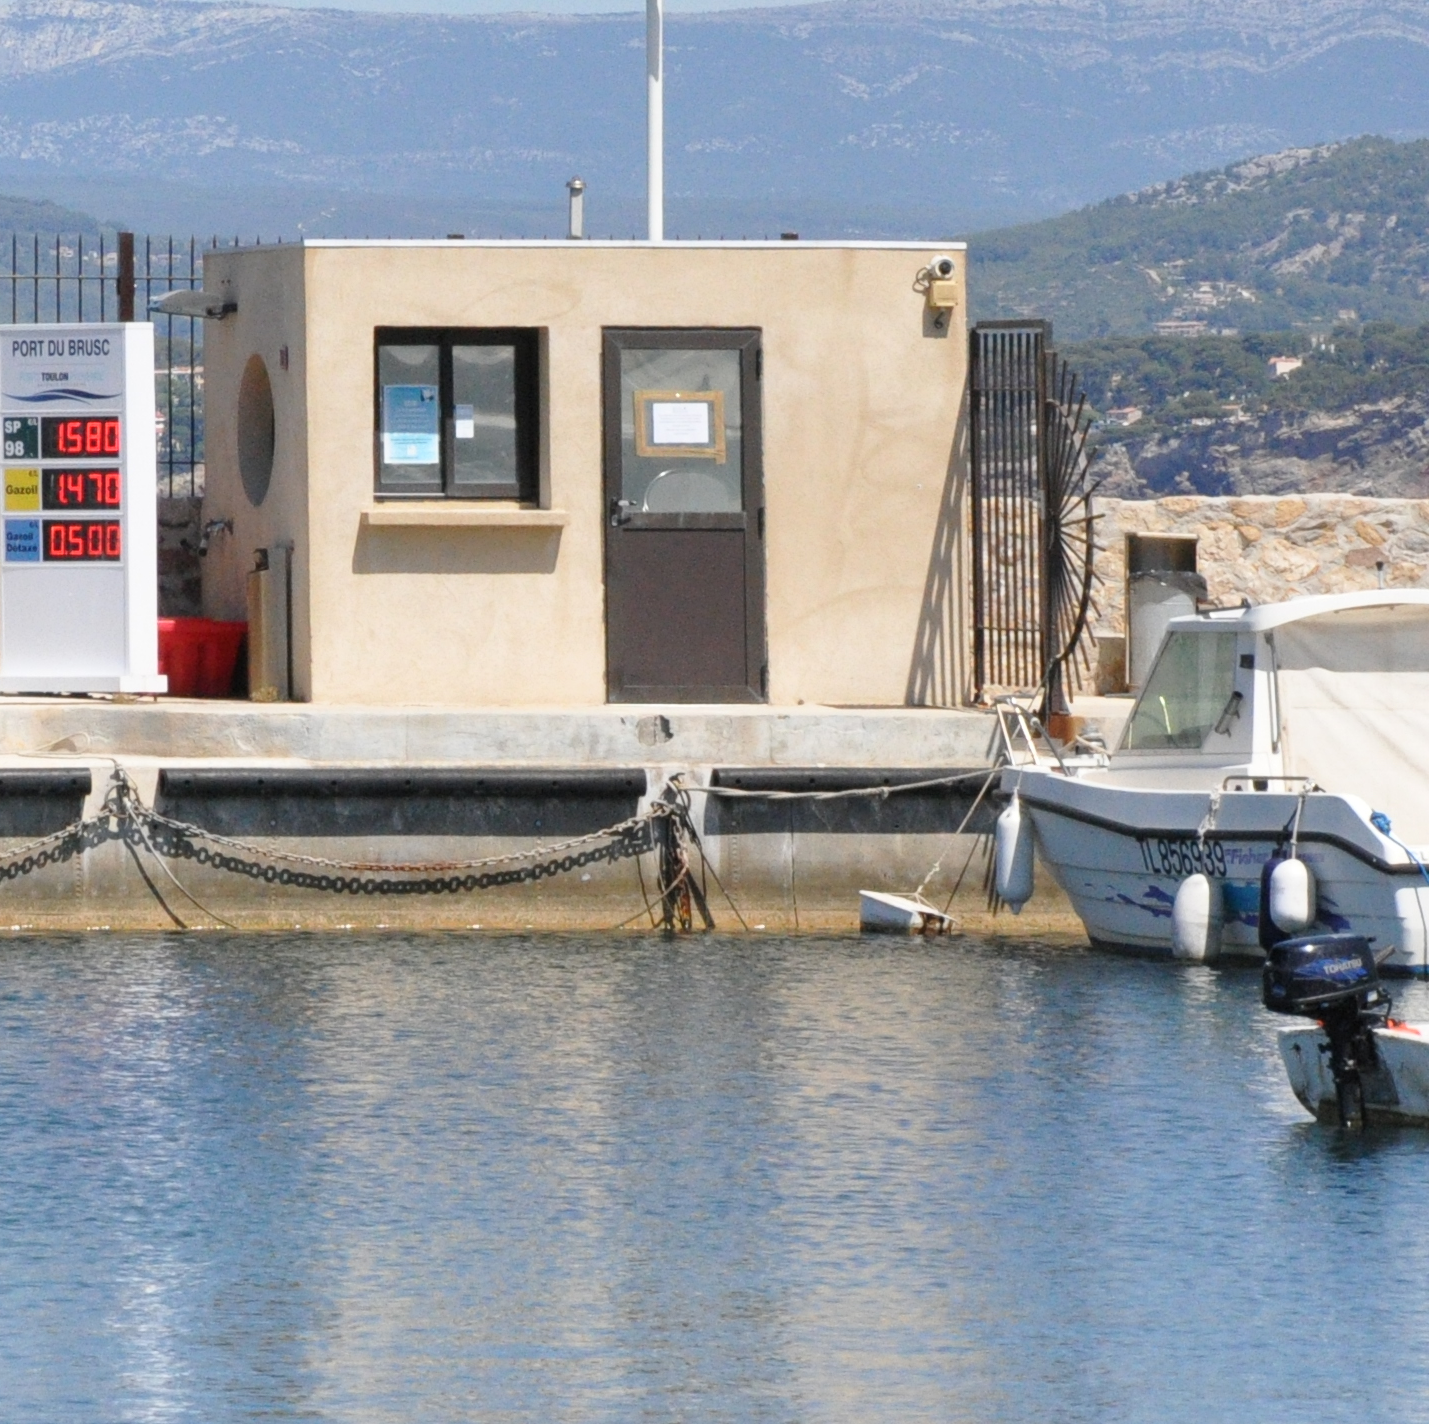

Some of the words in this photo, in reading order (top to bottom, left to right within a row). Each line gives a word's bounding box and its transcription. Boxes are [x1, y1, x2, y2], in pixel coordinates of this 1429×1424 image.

[12, 340, 44, 356] PORT
[48, 339, 65, 356] DU
[68, 338, 110, 356] BRUSC
[41, 372, 69, 381] TOULON
[4, 420, 21, 433] SP
[4, 440, 25, 456] 98
[5, 485, 38, 495] Gazoil
[6, 532, 34, 541] Gazoil
